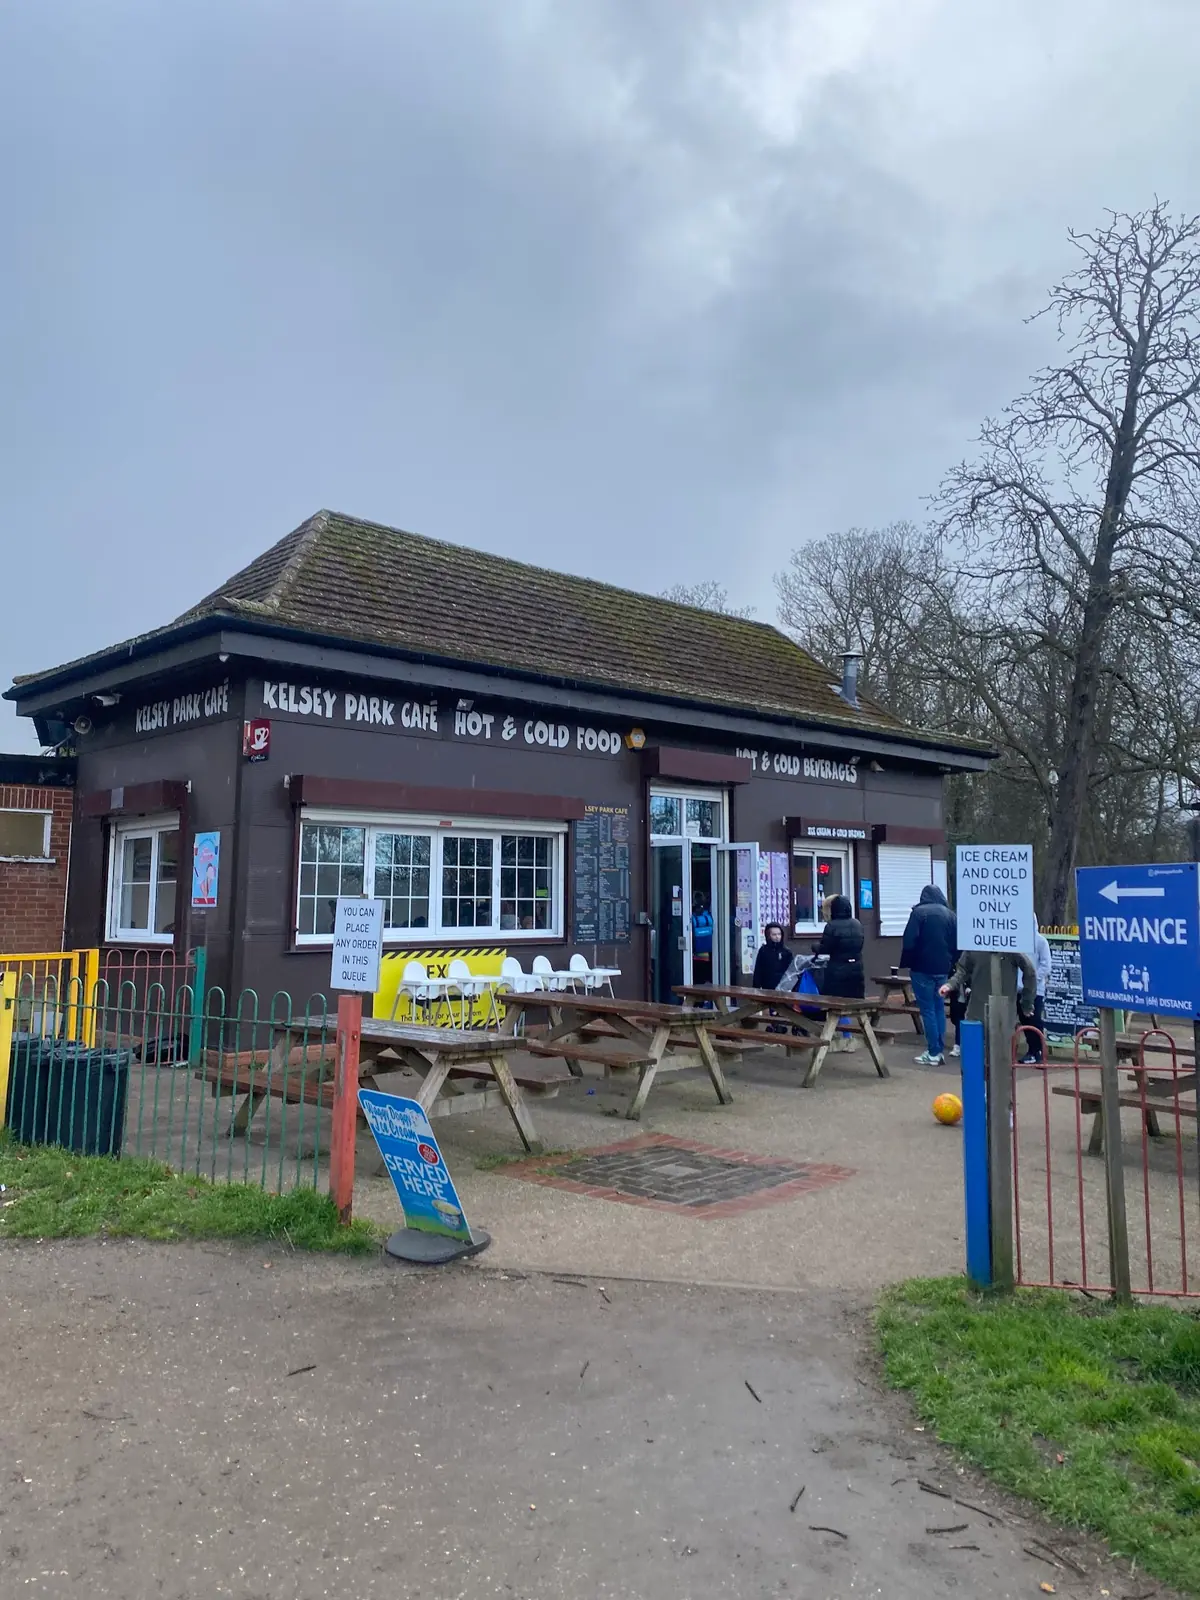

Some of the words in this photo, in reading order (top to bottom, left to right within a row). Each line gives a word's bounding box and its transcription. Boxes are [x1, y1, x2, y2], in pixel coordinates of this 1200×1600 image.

[263, 681, 337, 718] KELSEY
[344, 693, 395, 726] PARK
[401, 700, 438, 732] CAFÉ
[135, 701, 170, 733] KELSEY
[173, 694, 200, 725] PARK
[454, 711, 495, 739] HOT
[501, 715, 517, 741] &
[523, 720, 570, 748] COLD
[576, 726, 622, 755] FOOD
[761, 750, 771, 771] &
[773, 753, 800, 776] COLD
[803, 757, 858, 784] BEVERAGES
[600, 806, 614, 814] PARK
[961, 850, 980, 862] ICE
[983, 850, 1028, 862] CREAM
[962, 867, 989, 879] AND
[993, 867, 1027, 879] COLD
[970, 884, 1019, 896] DRINKS
[343, 907, 358, 917] YOU
[359, 907, 375, 917] CAN
[979, 901, 1011, 913] ONLY
[345, 922, 370, 933] PLACE
[972, 918, 985, 929] IN
[989, 918, 1018, 930] THIS
[1084, 916, 1188, 945] ENTRANCE
[335, 938, 351, 948] ANY
[352, 939, 378, 950] ORDER
[974, 934, 1017, 947] QUEUE
[342, 954, 351, 965] IN
[351, 955, 369, 966] THIS
[341, 970, 367, 982] QUEUE
[1088, 989, 1105, 999] PLEASE
[1105, 991, 1134, 1003] MAINTAIN
[1159, 998, 1193, 1011] DISTANCE
[401, 1014, 420, 1022] Thak
[446, 1011, 461, 1020] yur
[384, 1153, 449, 1185] SERVED
[401, 1173, 448, 1201] HERE
